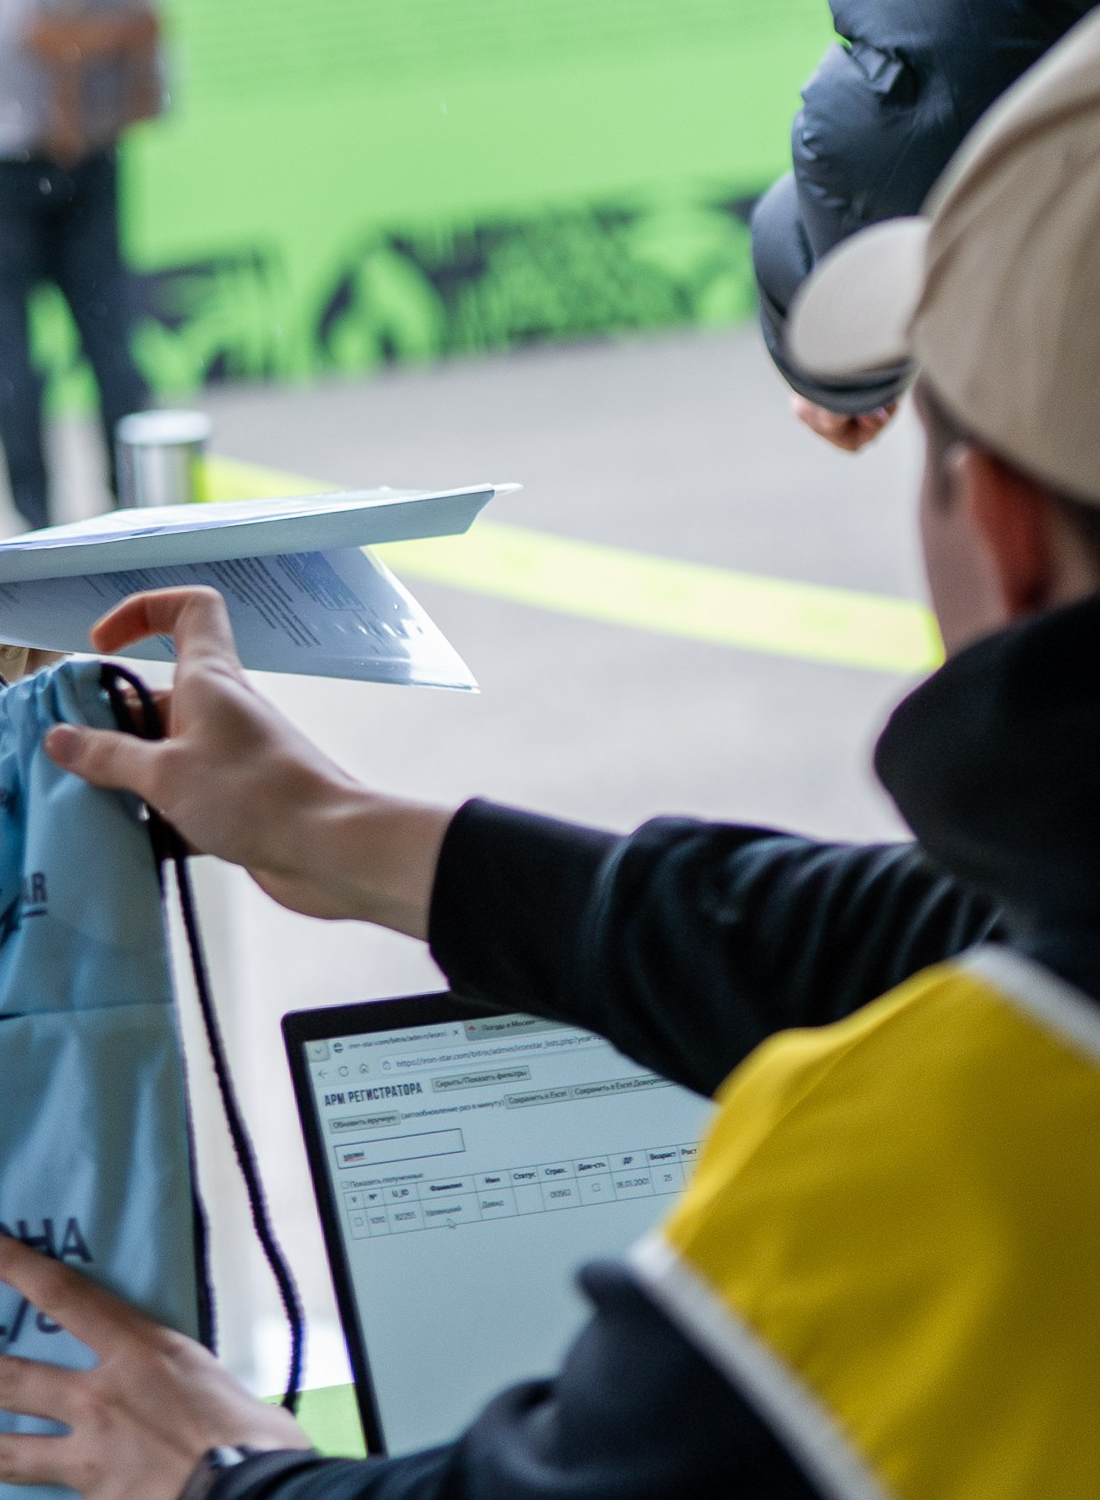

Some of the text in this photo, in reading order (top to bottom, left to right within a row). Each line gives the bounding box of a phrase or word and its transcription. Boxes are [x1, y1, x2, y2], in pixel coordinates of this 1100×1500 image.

[324, 1081, 424, 1107] АРМ РЕГИСТРАТОРА
[429, 1182, 463, 1192] Фамилия
[484, 1176, 501, 1184] Имя
[512, 1171, 537, 1182] Статус
[622, 1155, 634, 1166] ДР
[649, 1150, 677, 1161] Возраст
[681, 1148, 698, 1156] Рост
